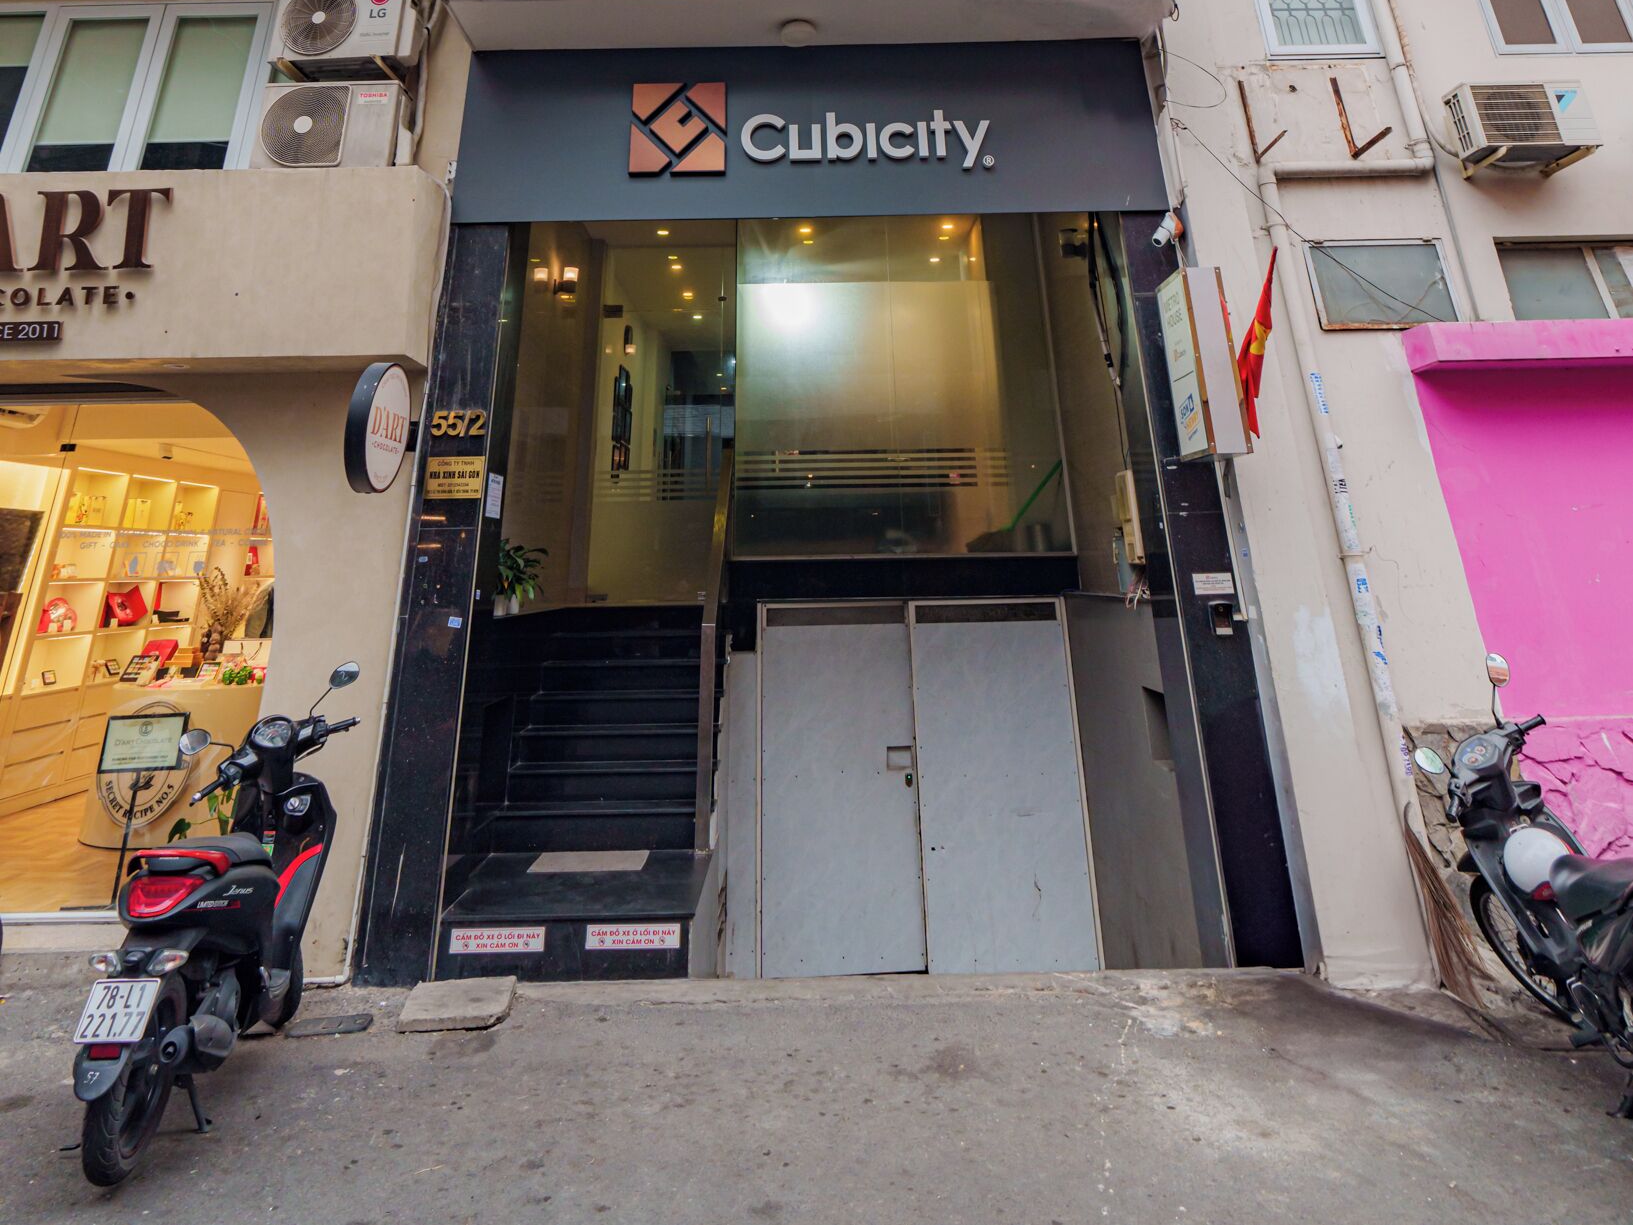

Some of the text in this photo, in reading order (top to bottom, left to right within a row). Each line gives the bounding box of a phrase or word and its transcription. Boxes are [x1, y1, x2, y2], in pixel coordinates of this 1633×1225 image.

[369, 8, 387, 19] LG
[741, 109, 990, 170] Cubicity
[18, 323, 60, 339] 2011
[371, 405, 408, 444] D'ART
[431, 409, 487, 437] 55/2
[105, 780, 124, 814] SECRET
[122, 801, 156, 819] RCIPE
[96, 983, 147, 1010] 78-L1
[80, 1011, 146, 1039] 221.77
